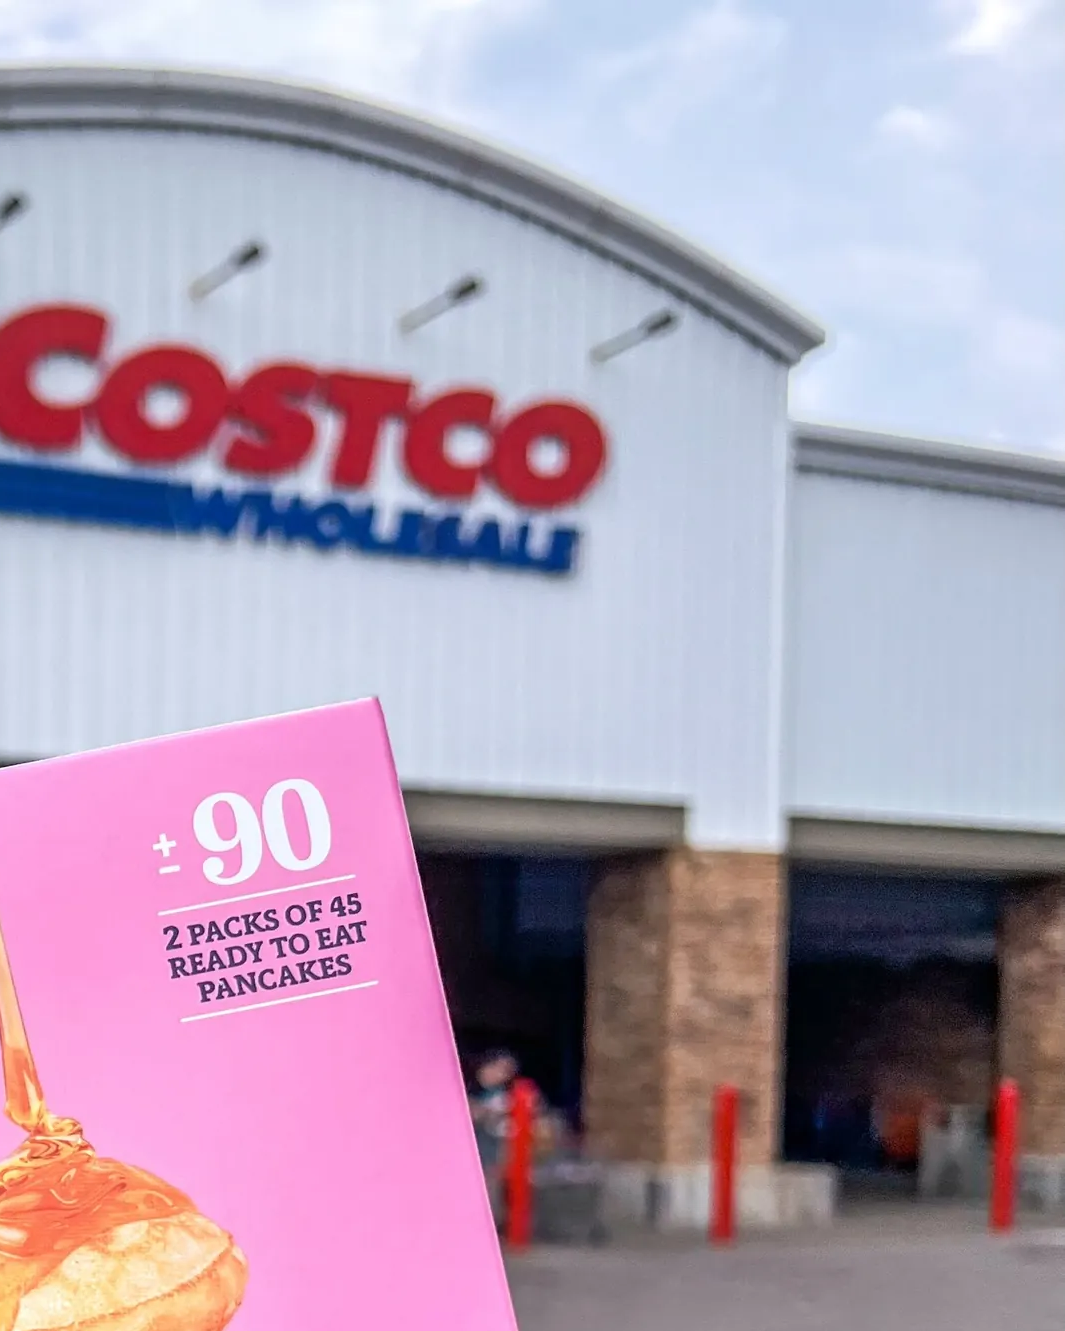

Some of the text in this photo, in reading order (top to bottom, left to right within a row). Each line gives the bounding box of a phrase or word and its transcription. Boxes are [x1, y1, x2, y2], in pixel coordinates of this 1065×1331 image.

[185, 478, 580, 574] WHOLESALE
[163, 892, 362, 951] 2 PACKS OF 45
[168, 920, 368, 979] READY TO EAT
[197, 953, 353, 1003] PANCAKES
